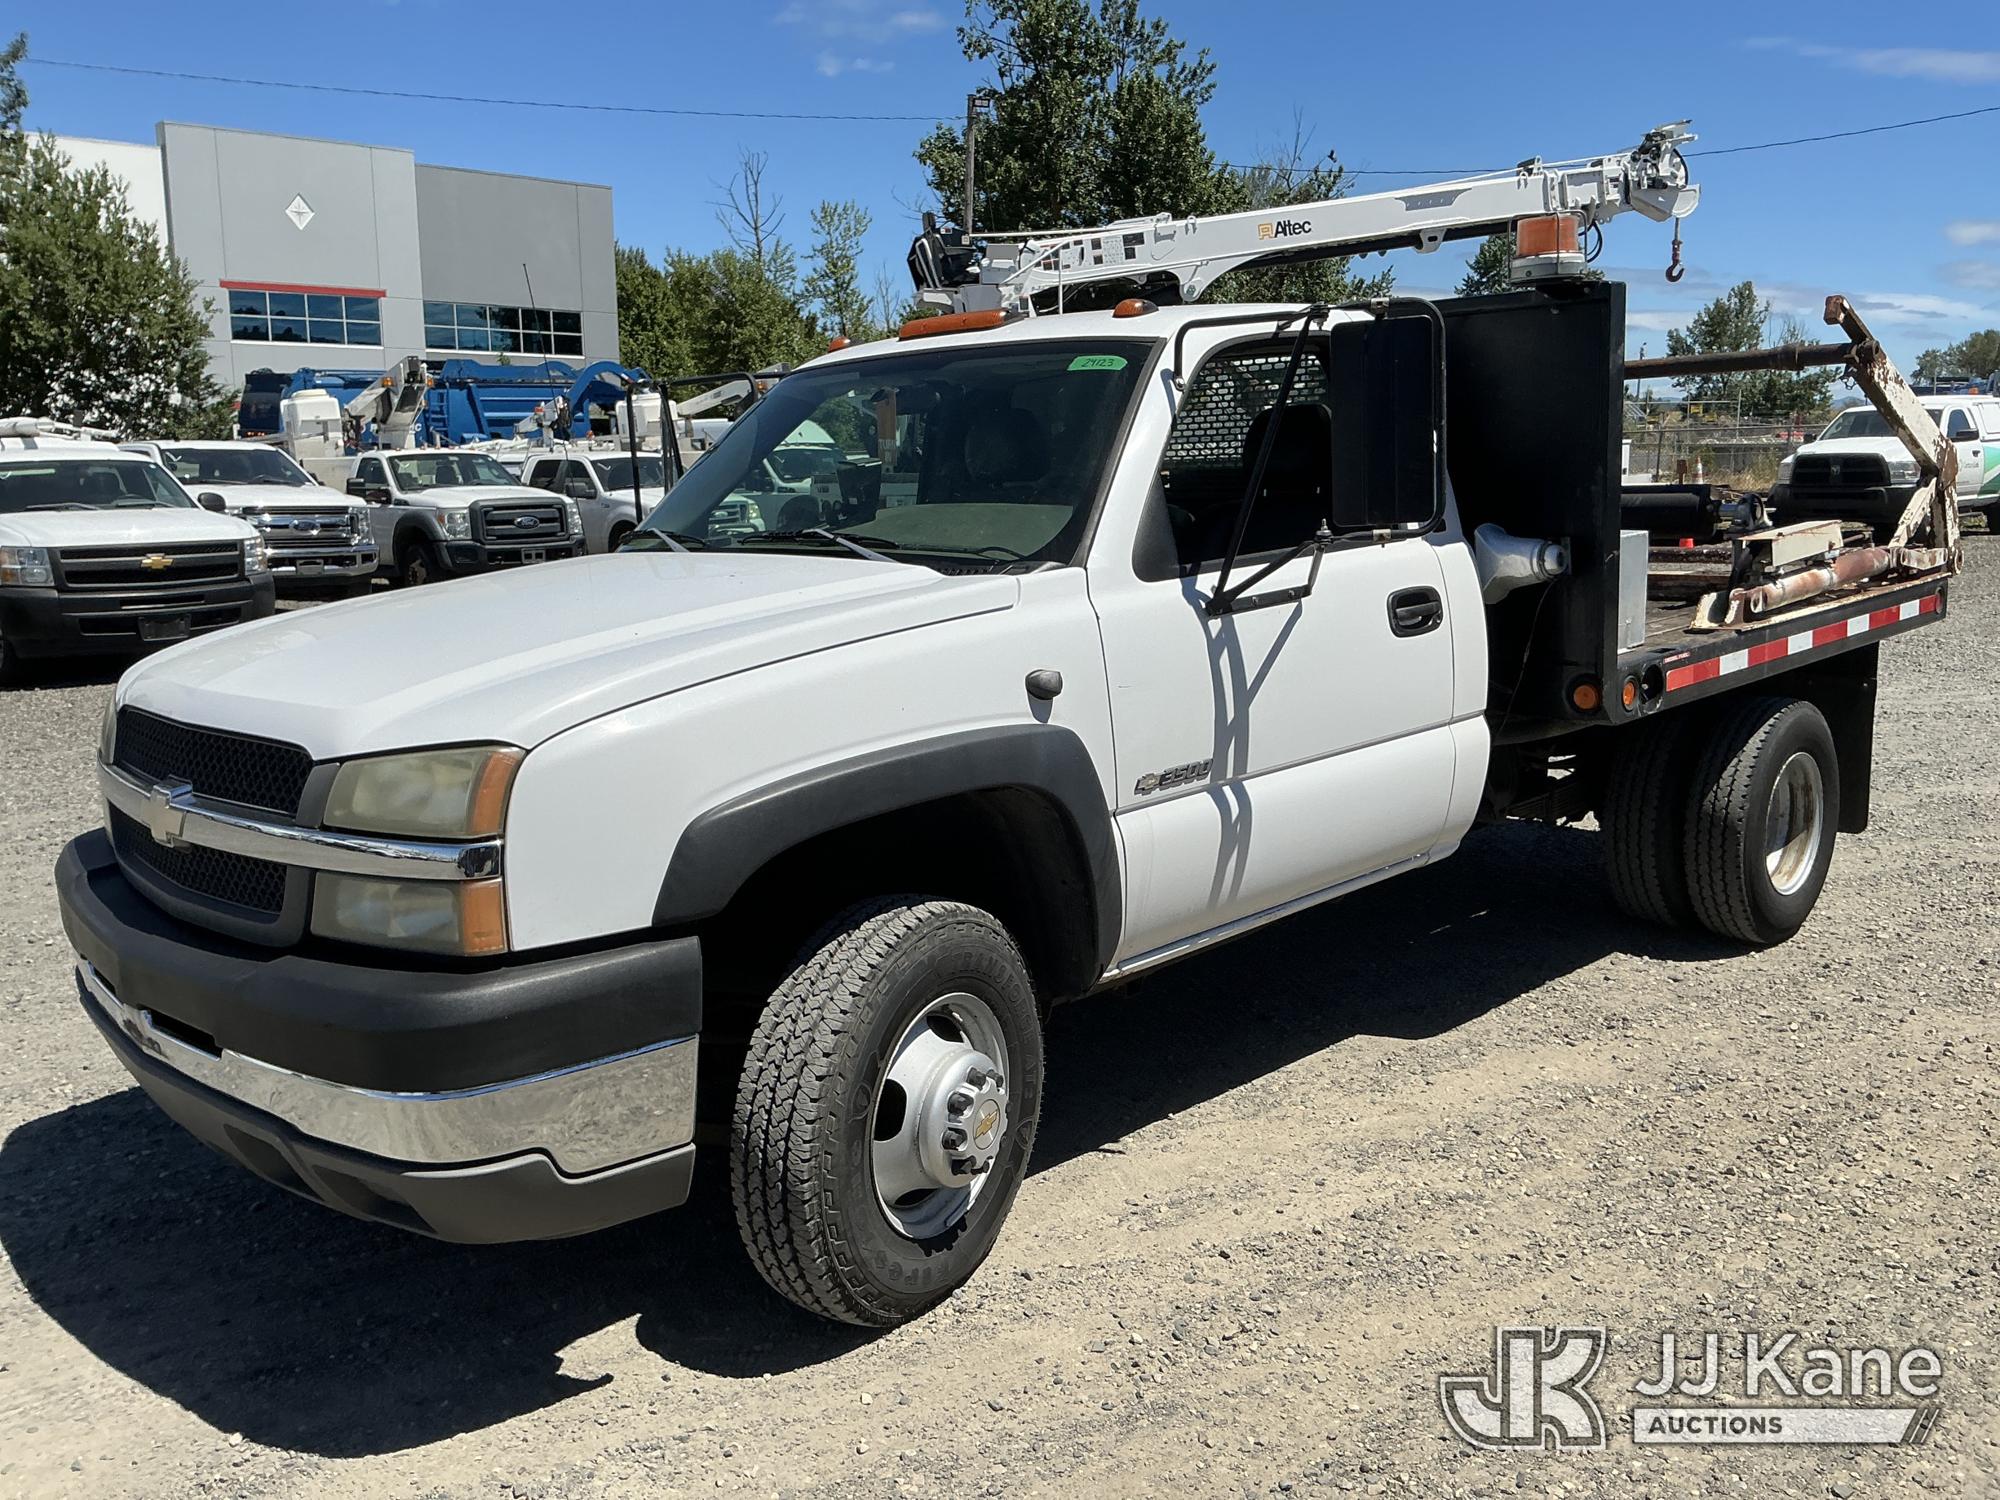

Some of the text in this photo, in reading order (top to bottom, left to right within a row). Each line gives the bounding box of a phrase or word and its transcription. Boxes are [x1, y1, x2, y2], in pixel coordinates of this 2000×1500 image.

[1274, 219, 1312, 238] Altec
[1081, 358, 1115, 369] 24123
[1159, 759, 1213, 787] 3500
